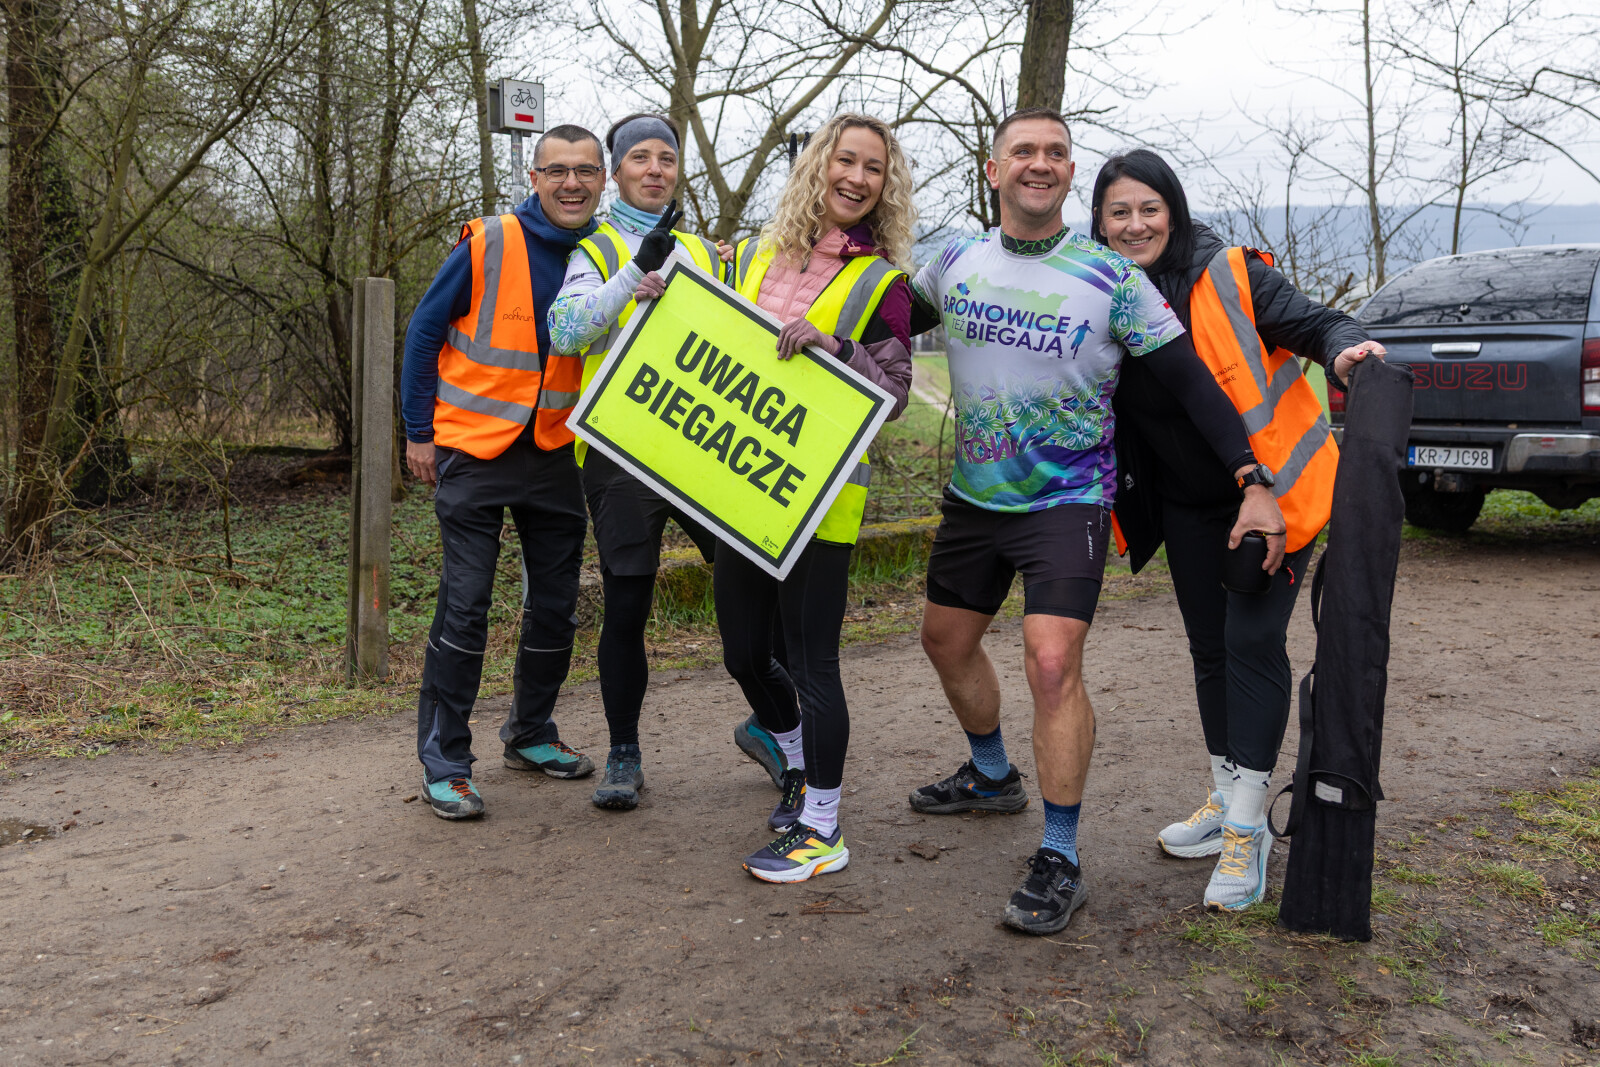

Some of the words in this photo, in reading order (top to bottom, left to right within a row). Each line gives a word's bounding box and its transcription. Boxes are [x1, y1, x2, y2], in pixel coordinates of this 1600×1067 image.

[944, 295, 1071, 334] BRONOWICE
[952, 317, 965, 332] TEŻ
[966, 321, 1063, 359] BIEGAJĄ
[675, 330, 808, 447] UWAGA
[1410, 363, 1527, 390] SUZU
[624, 362, 807, 509] BIEGACZE
[955, 421, 1018, 464] KÓW
[1417, 447, 1437, 465] KR
[1443, 449, 1489, 467] 7JC98
